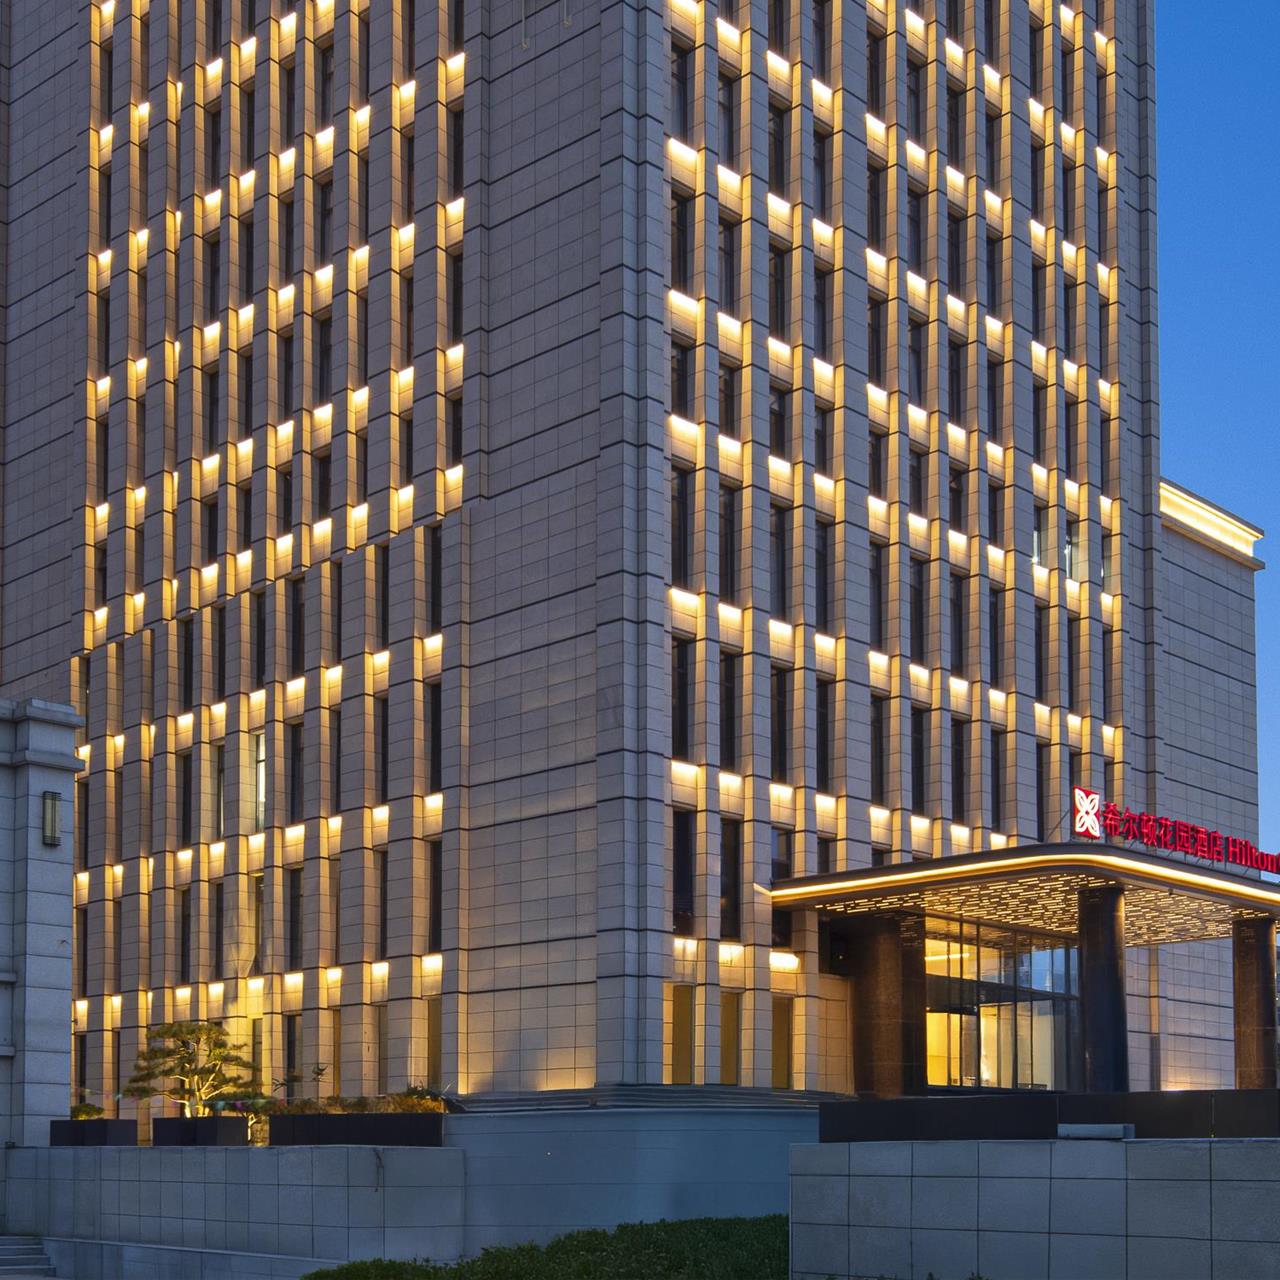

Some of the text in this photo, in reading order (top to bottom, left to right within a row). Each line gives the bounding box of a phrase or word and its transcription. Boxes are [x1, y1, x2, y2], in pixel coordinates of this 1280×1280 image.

[1103, 801, 1224, 862] 希尔顿花园酒店
